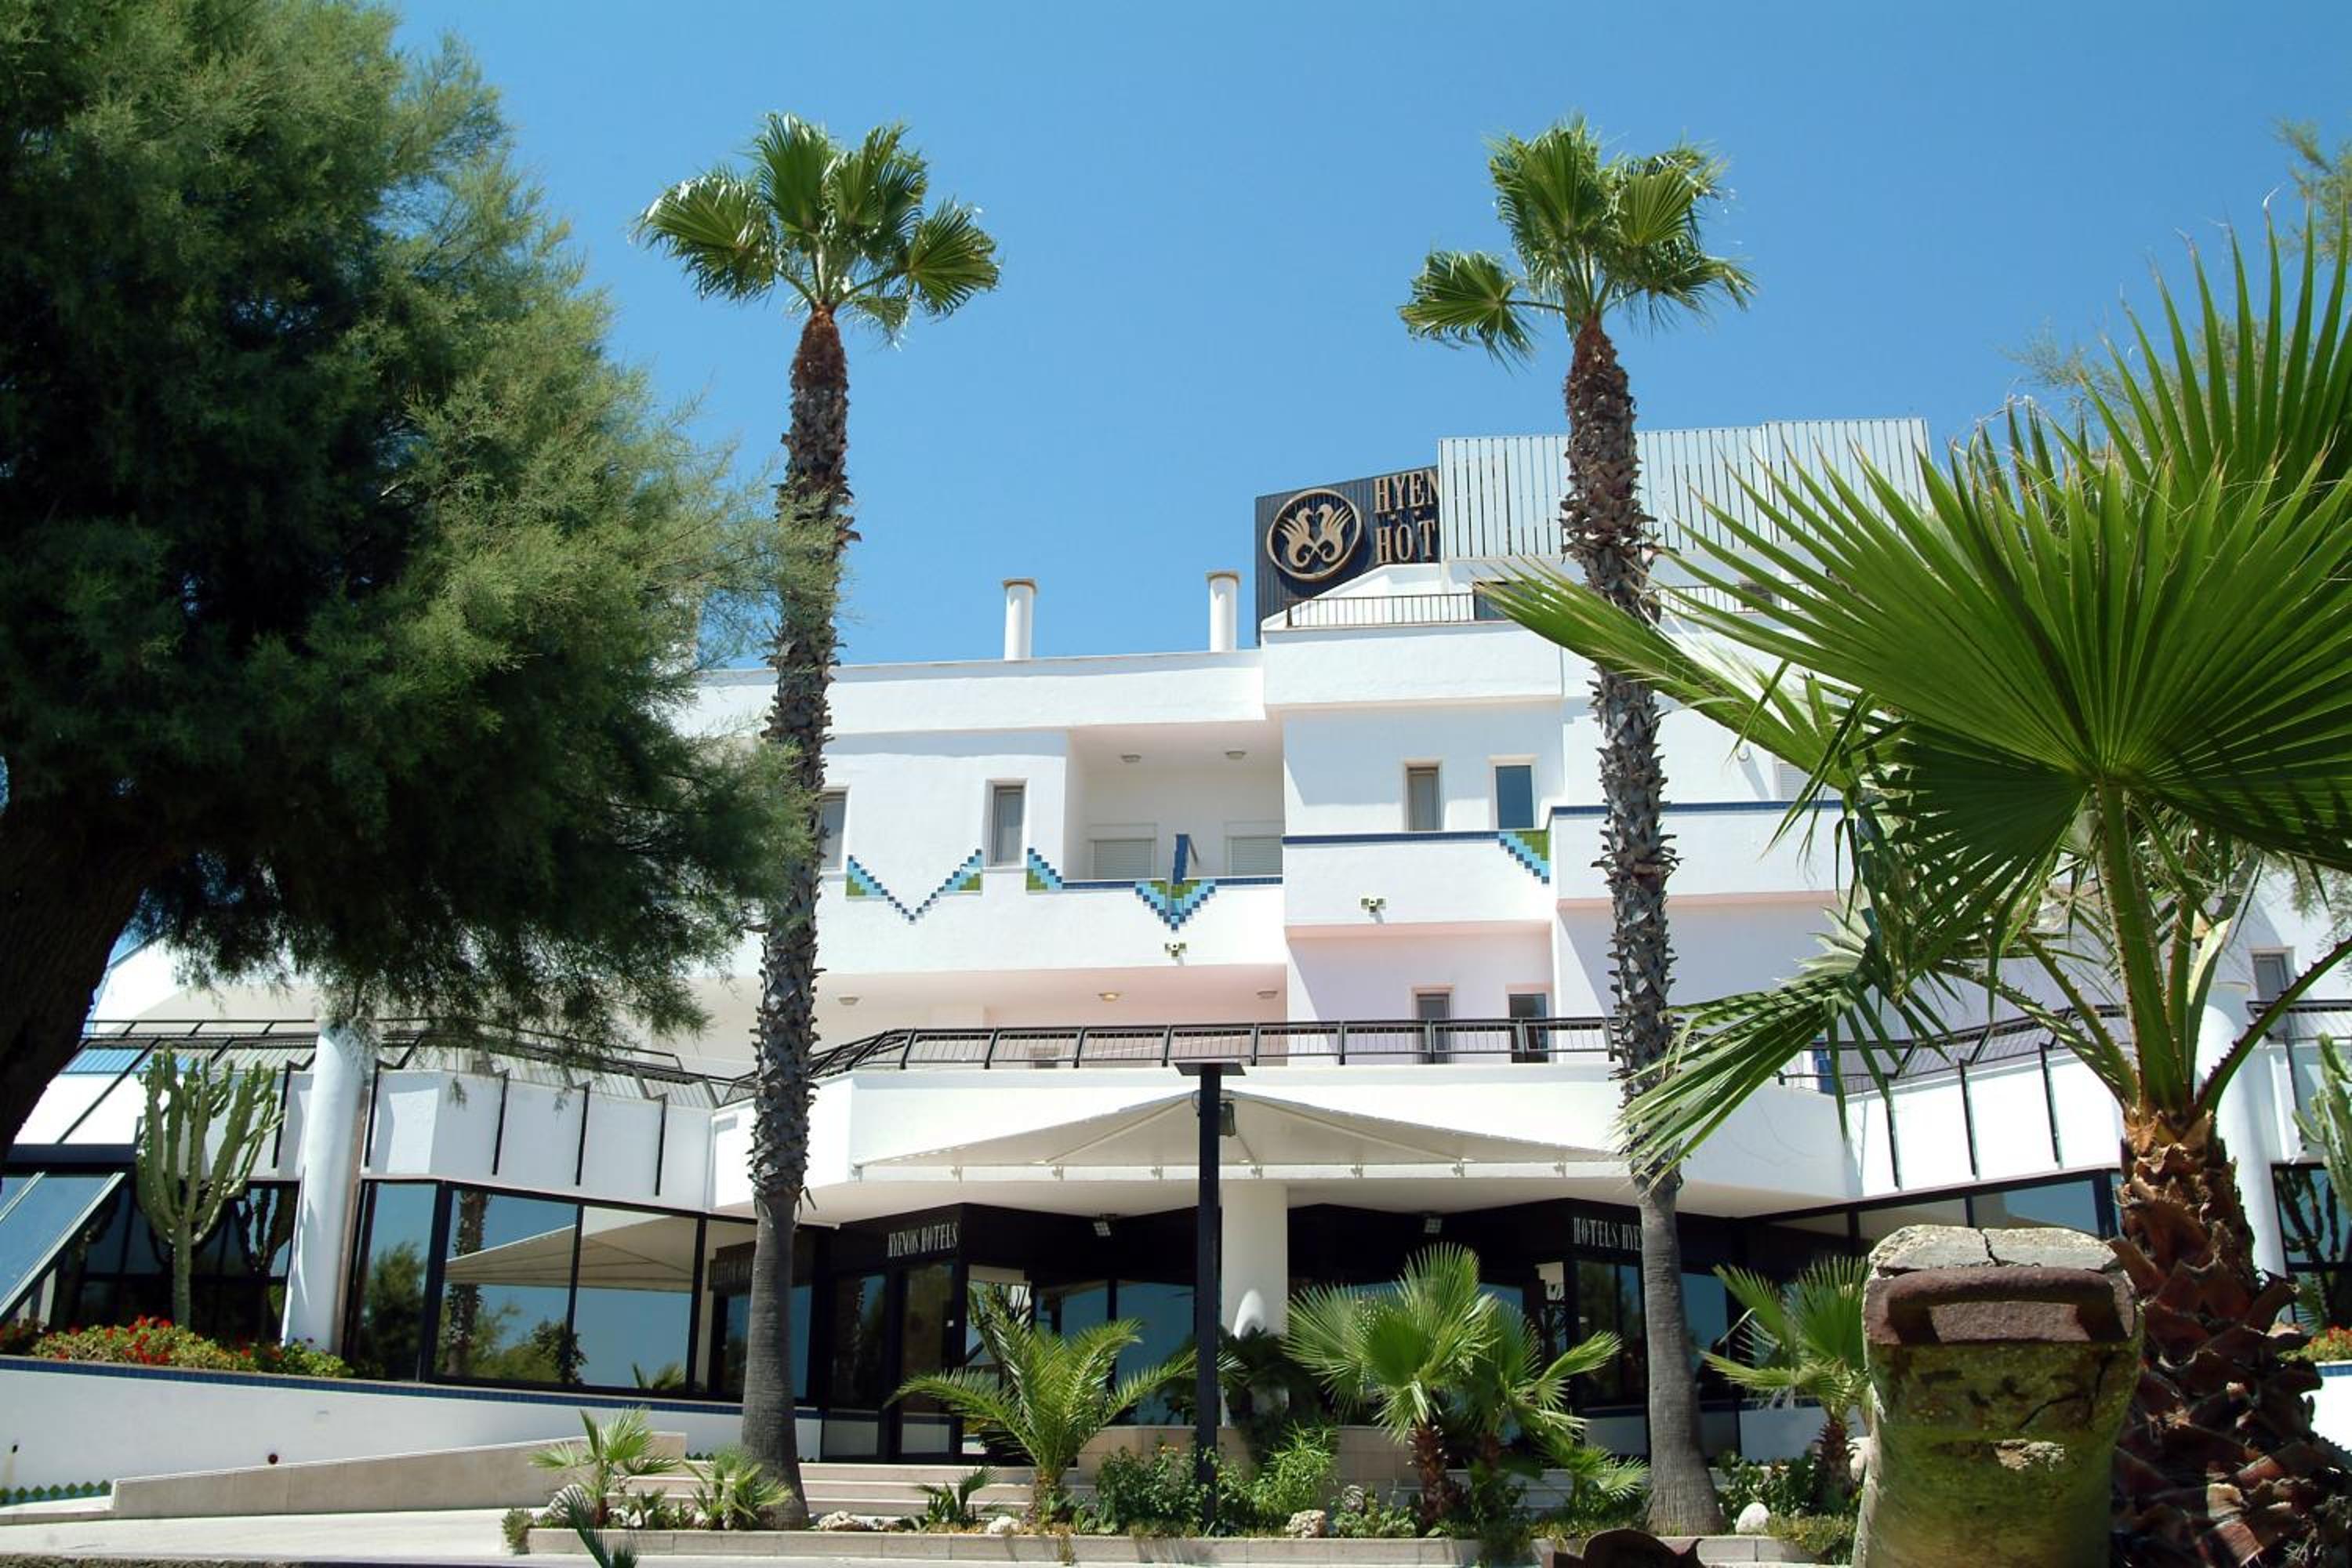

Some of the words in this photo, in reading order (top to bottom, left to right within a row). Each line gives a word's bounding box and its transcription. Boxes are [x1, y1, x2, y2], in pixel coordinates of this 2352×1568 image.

[1375, 520, 1436, 563] HOT
[1573, 1217, 1618, 1248] HOTELS
[1622, 1224, 1643, 1250] HYE
